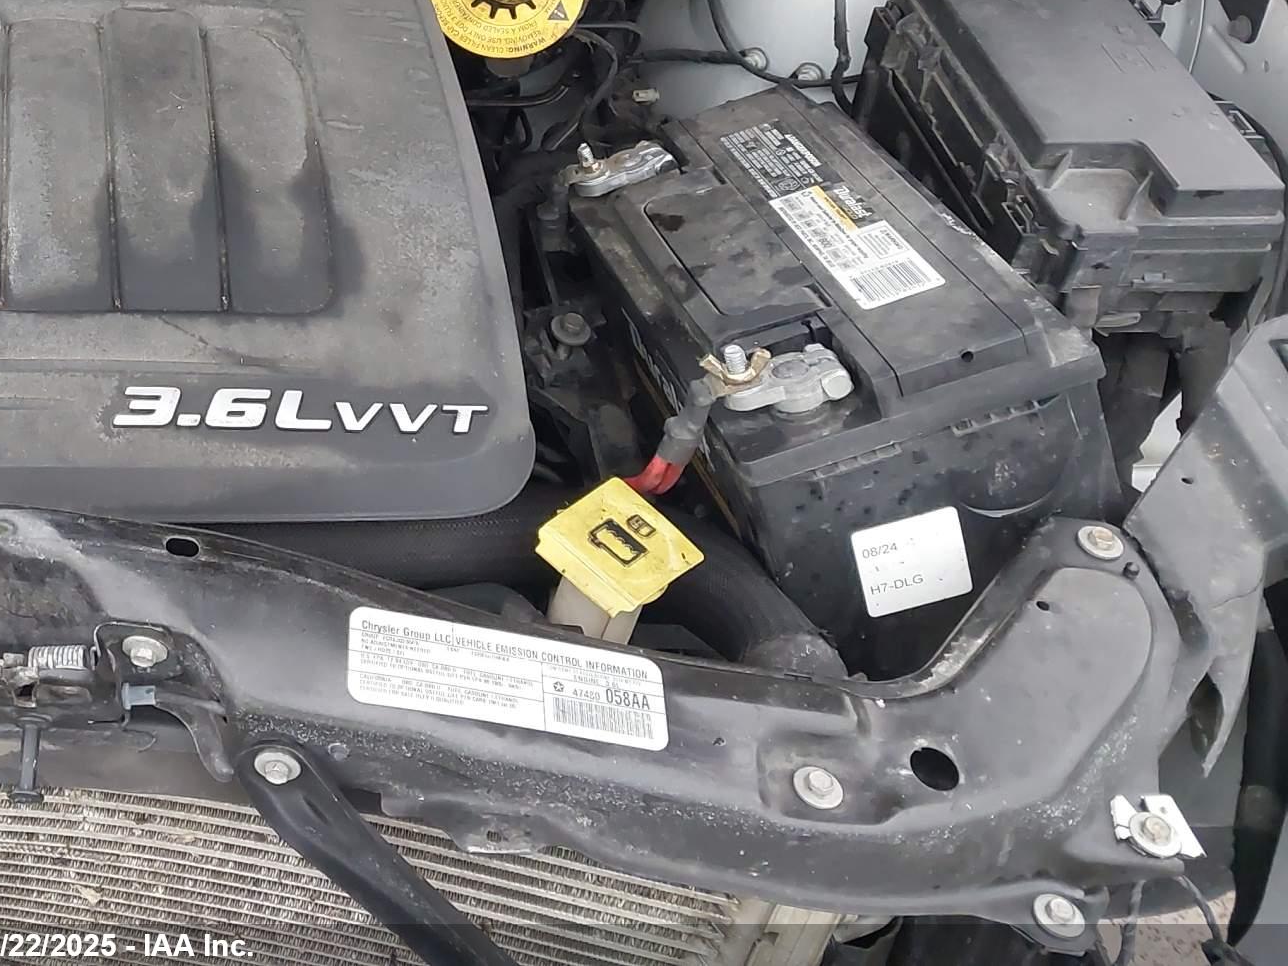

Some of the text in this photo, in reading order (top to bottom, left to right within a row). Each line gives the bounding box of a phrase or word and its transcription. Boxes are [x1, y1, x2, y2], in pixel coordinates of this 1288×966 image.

[833, 186, 872, 218] Duralast
[862, 542, 898, 559] 08/24
[870, 574, 924, 595] H7-DLG
[362, 620, 400, 635] Chrysler
[403, 626, 431, 641] Group
[434, 633, 452, 644] LLC
[455, 636, 492, 651] VEHICLE
[495, 643, 538, 659] EMISSION
[541, 651, 582, 667] CONTROL
[585, 660, 648, 679] INFORMATION
[605, 688, 651, 710] 058AA
